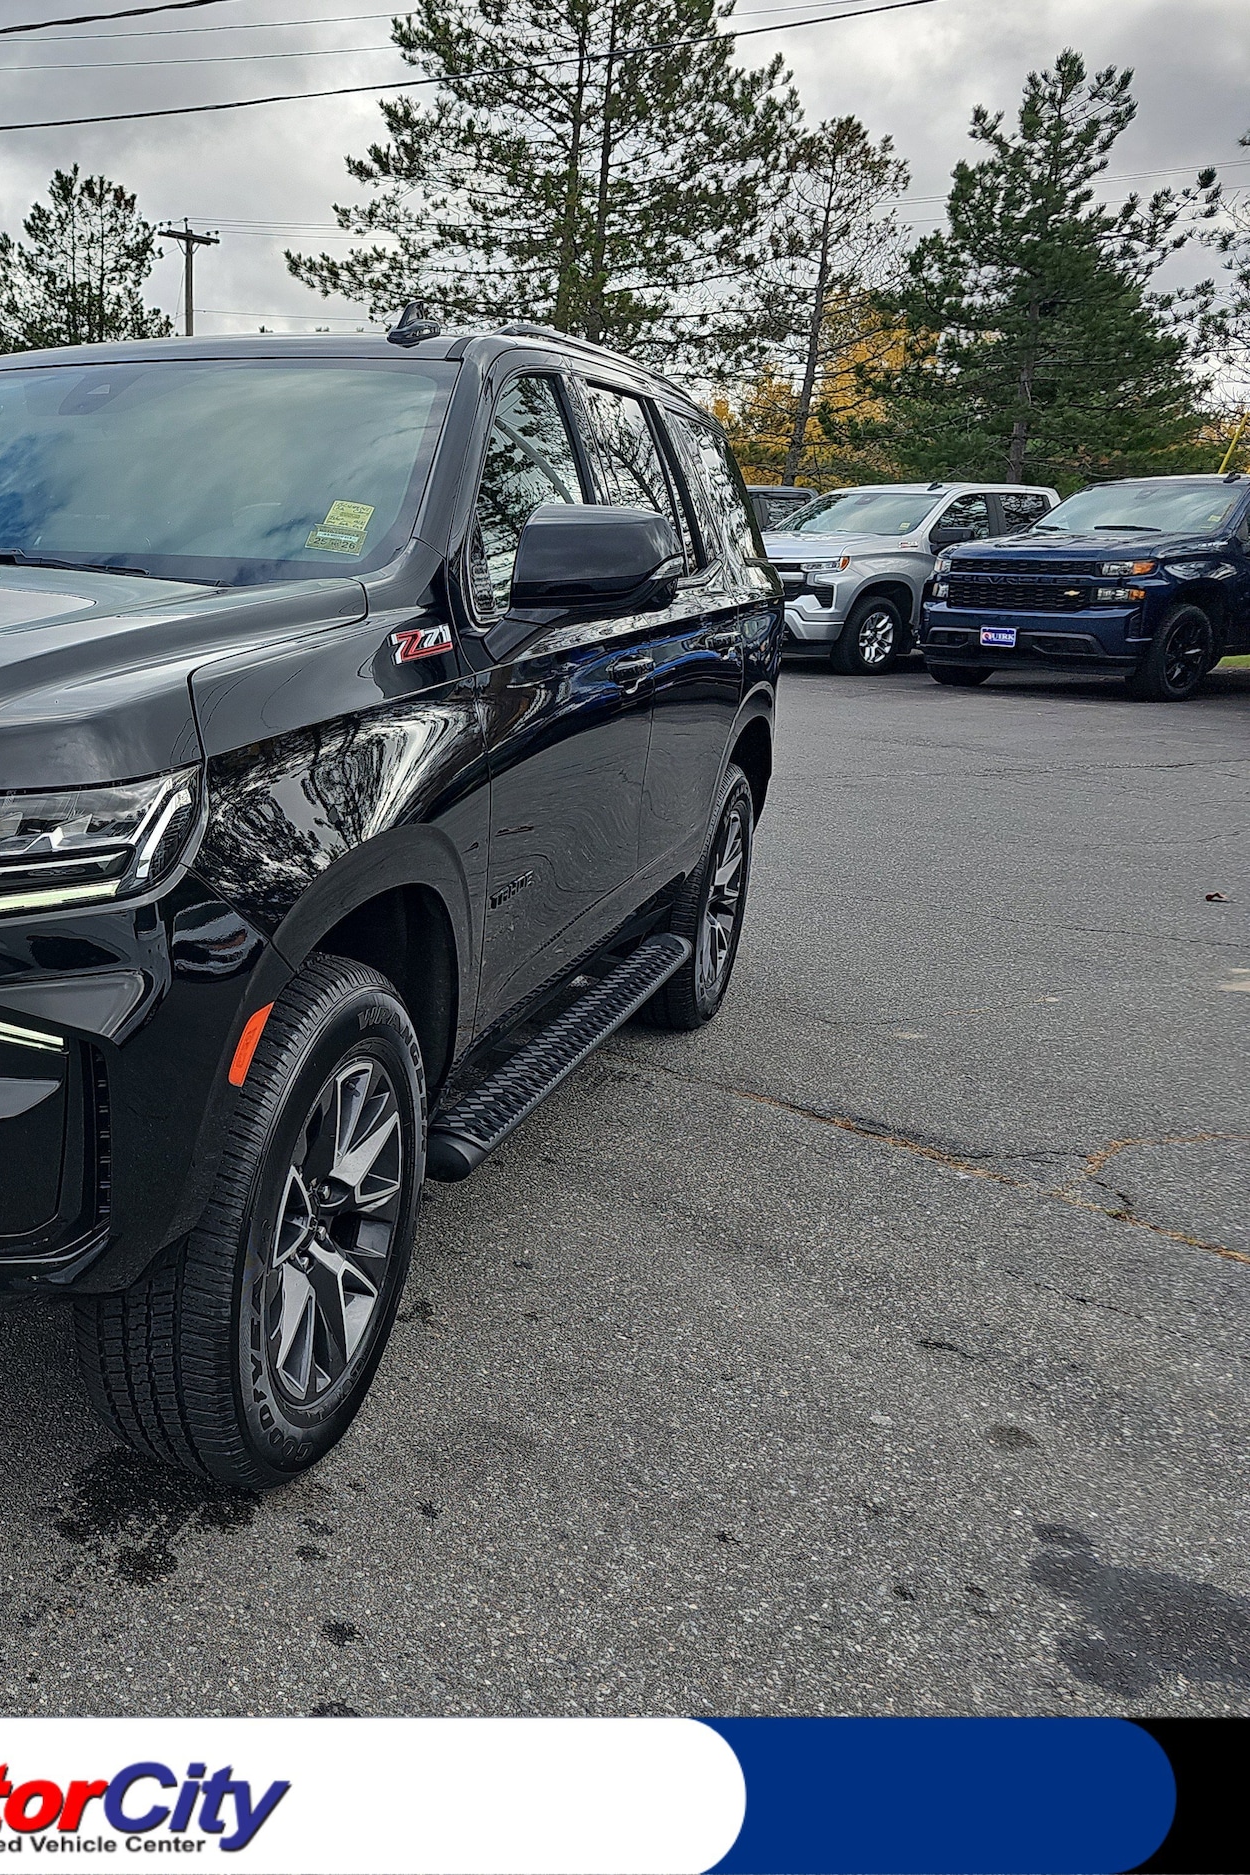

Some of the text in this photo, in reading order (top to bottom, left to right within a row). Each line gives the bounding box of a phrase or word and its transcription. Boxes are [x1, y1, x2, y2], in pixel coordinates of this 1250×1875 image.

[341, 541, 356, 550] 26
[390, 623, 453, 665] Z71
[982, 632, 1015, 641] QUIRK
[357, 1006, 428, 1153] WRANGLER
[249, 1218, 313, 1462] GOODYEA
